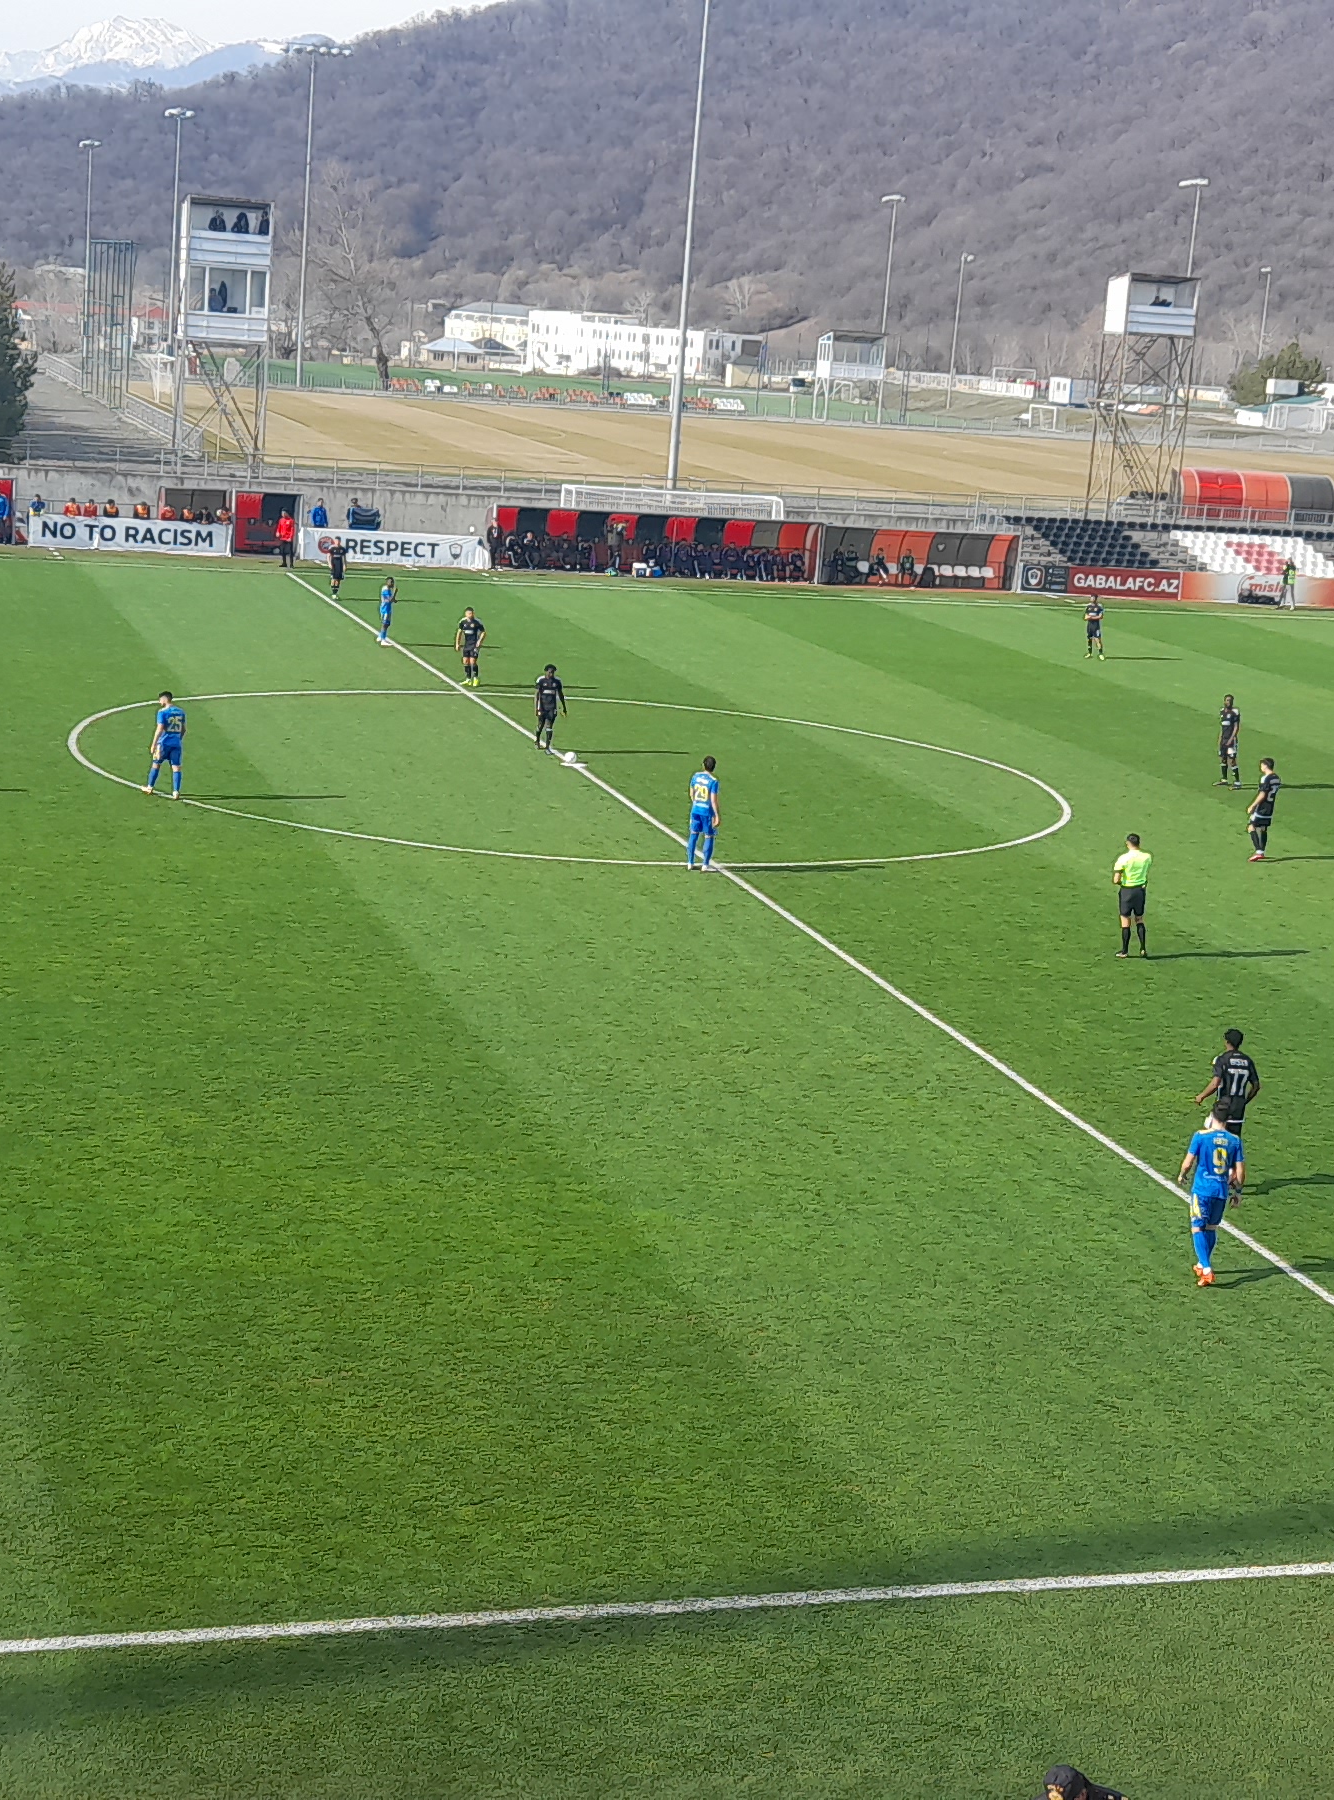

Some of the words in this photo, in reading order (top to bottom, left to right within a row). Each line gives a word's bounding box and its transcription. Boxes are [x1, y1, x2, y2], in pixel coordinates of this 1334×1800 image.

[41, 521, 76, 539] NO
[84, 523, 116, 541] TO
[125, 526, 213, 548] RACISM
[346, 538, 440, 558] RESPECT
[1074, 573, 1179, 593] GABALAFC.AZ
[1228, 1069, 1249, 1095] 77
[1213, 1147, 1227, 1174] 9
